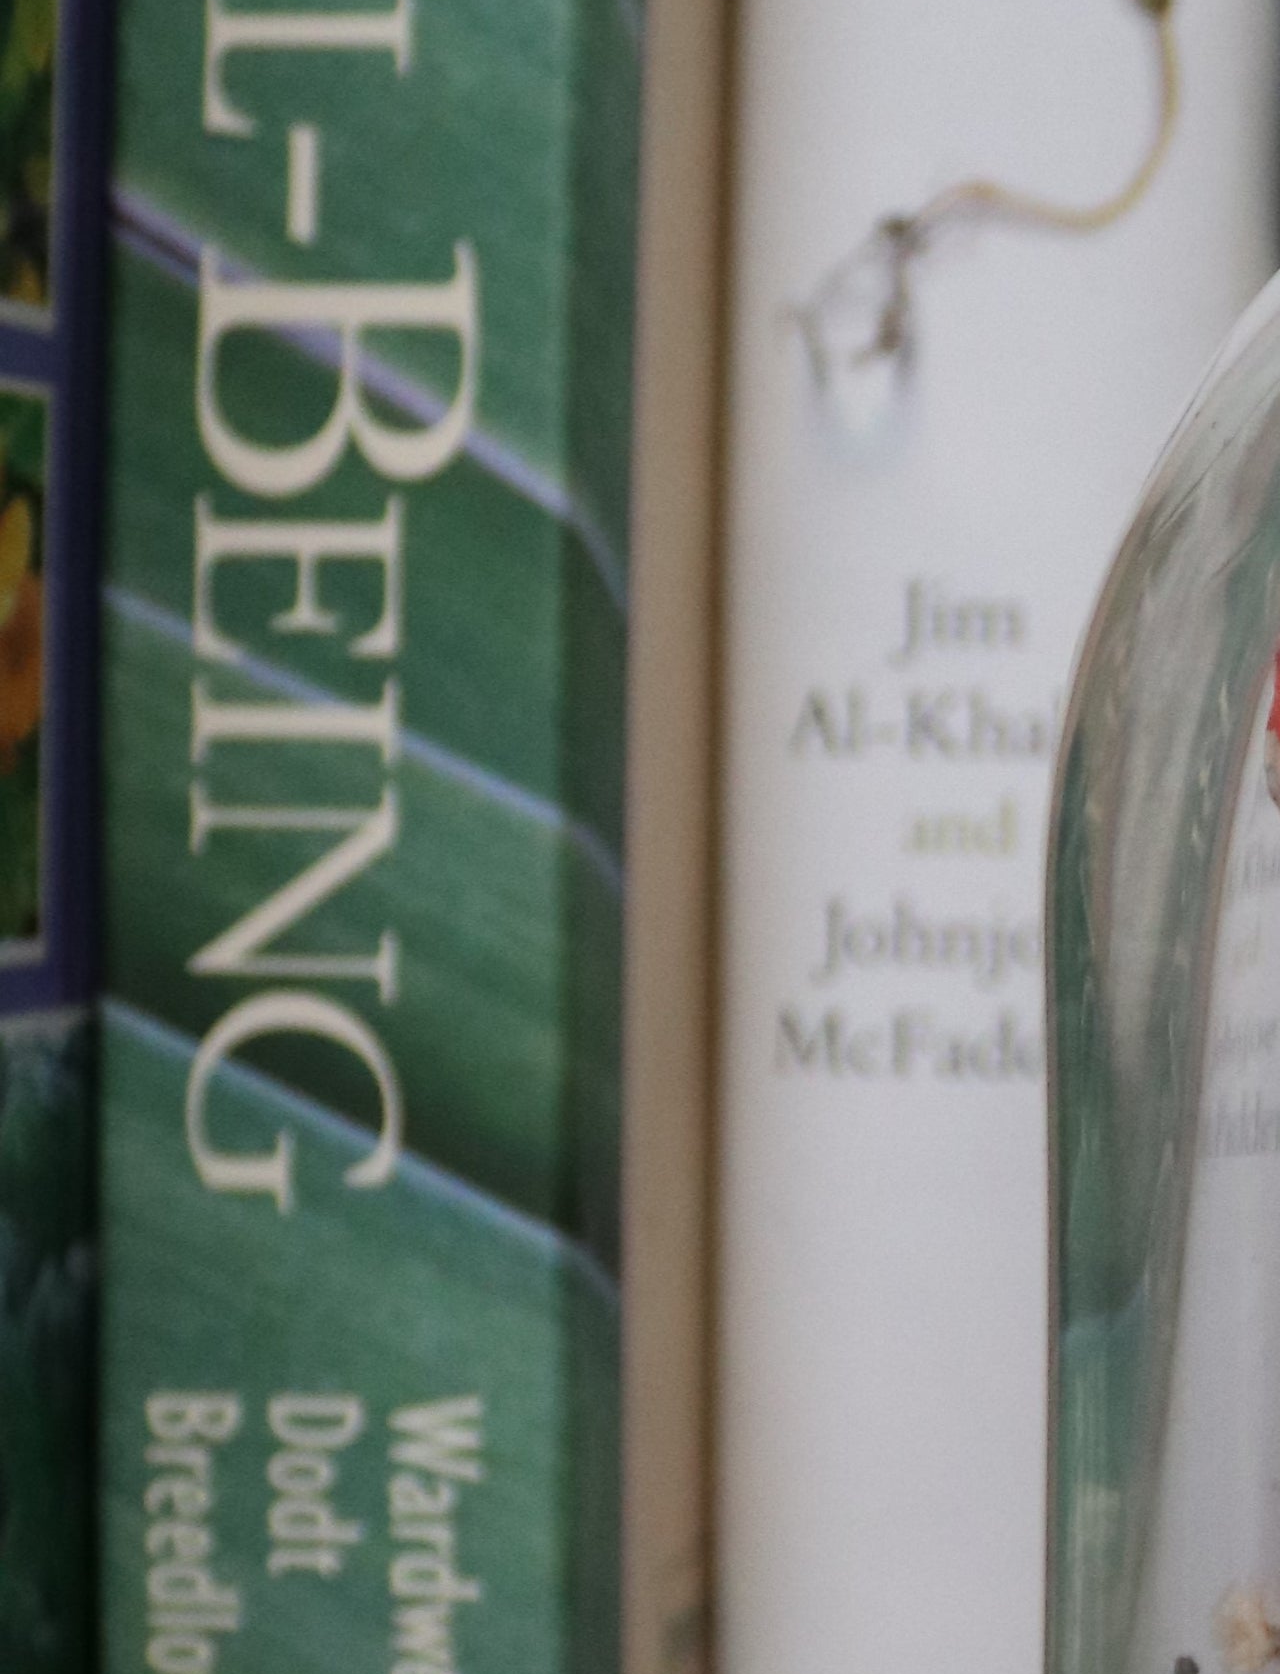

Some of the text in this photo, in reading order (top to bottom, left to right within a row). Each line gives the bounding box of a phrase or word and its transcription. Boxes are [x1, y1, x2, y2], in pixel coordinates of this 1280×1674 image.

[888, 577, 1025, 670] Jim
[903, 793, 1018, 857] and
[267, 1393, 365, 1576] Dodt
